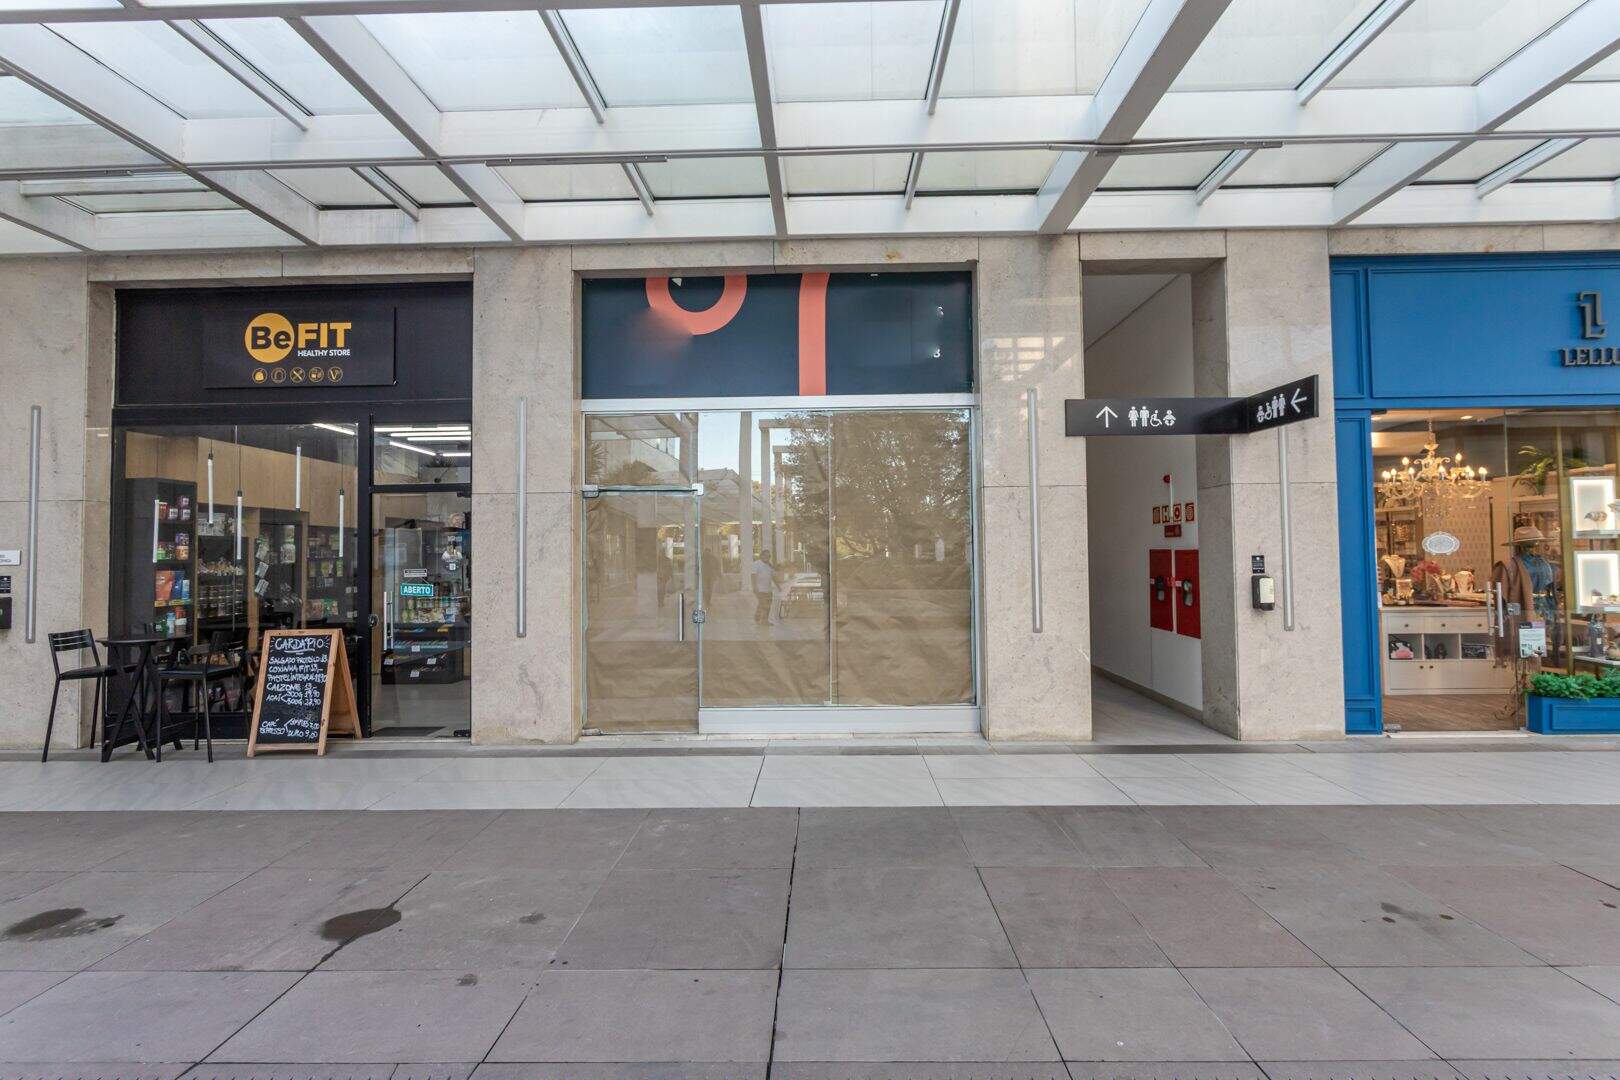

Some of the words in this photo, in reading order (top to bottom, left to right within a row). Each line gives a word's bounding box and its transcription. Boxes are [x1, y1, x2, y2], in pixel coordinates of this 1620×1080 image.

[403, 585, 431, 595] ABERTO
[268, 665, 298, 673] COXINHA
[266, 682, 301, 691] CALZONE
